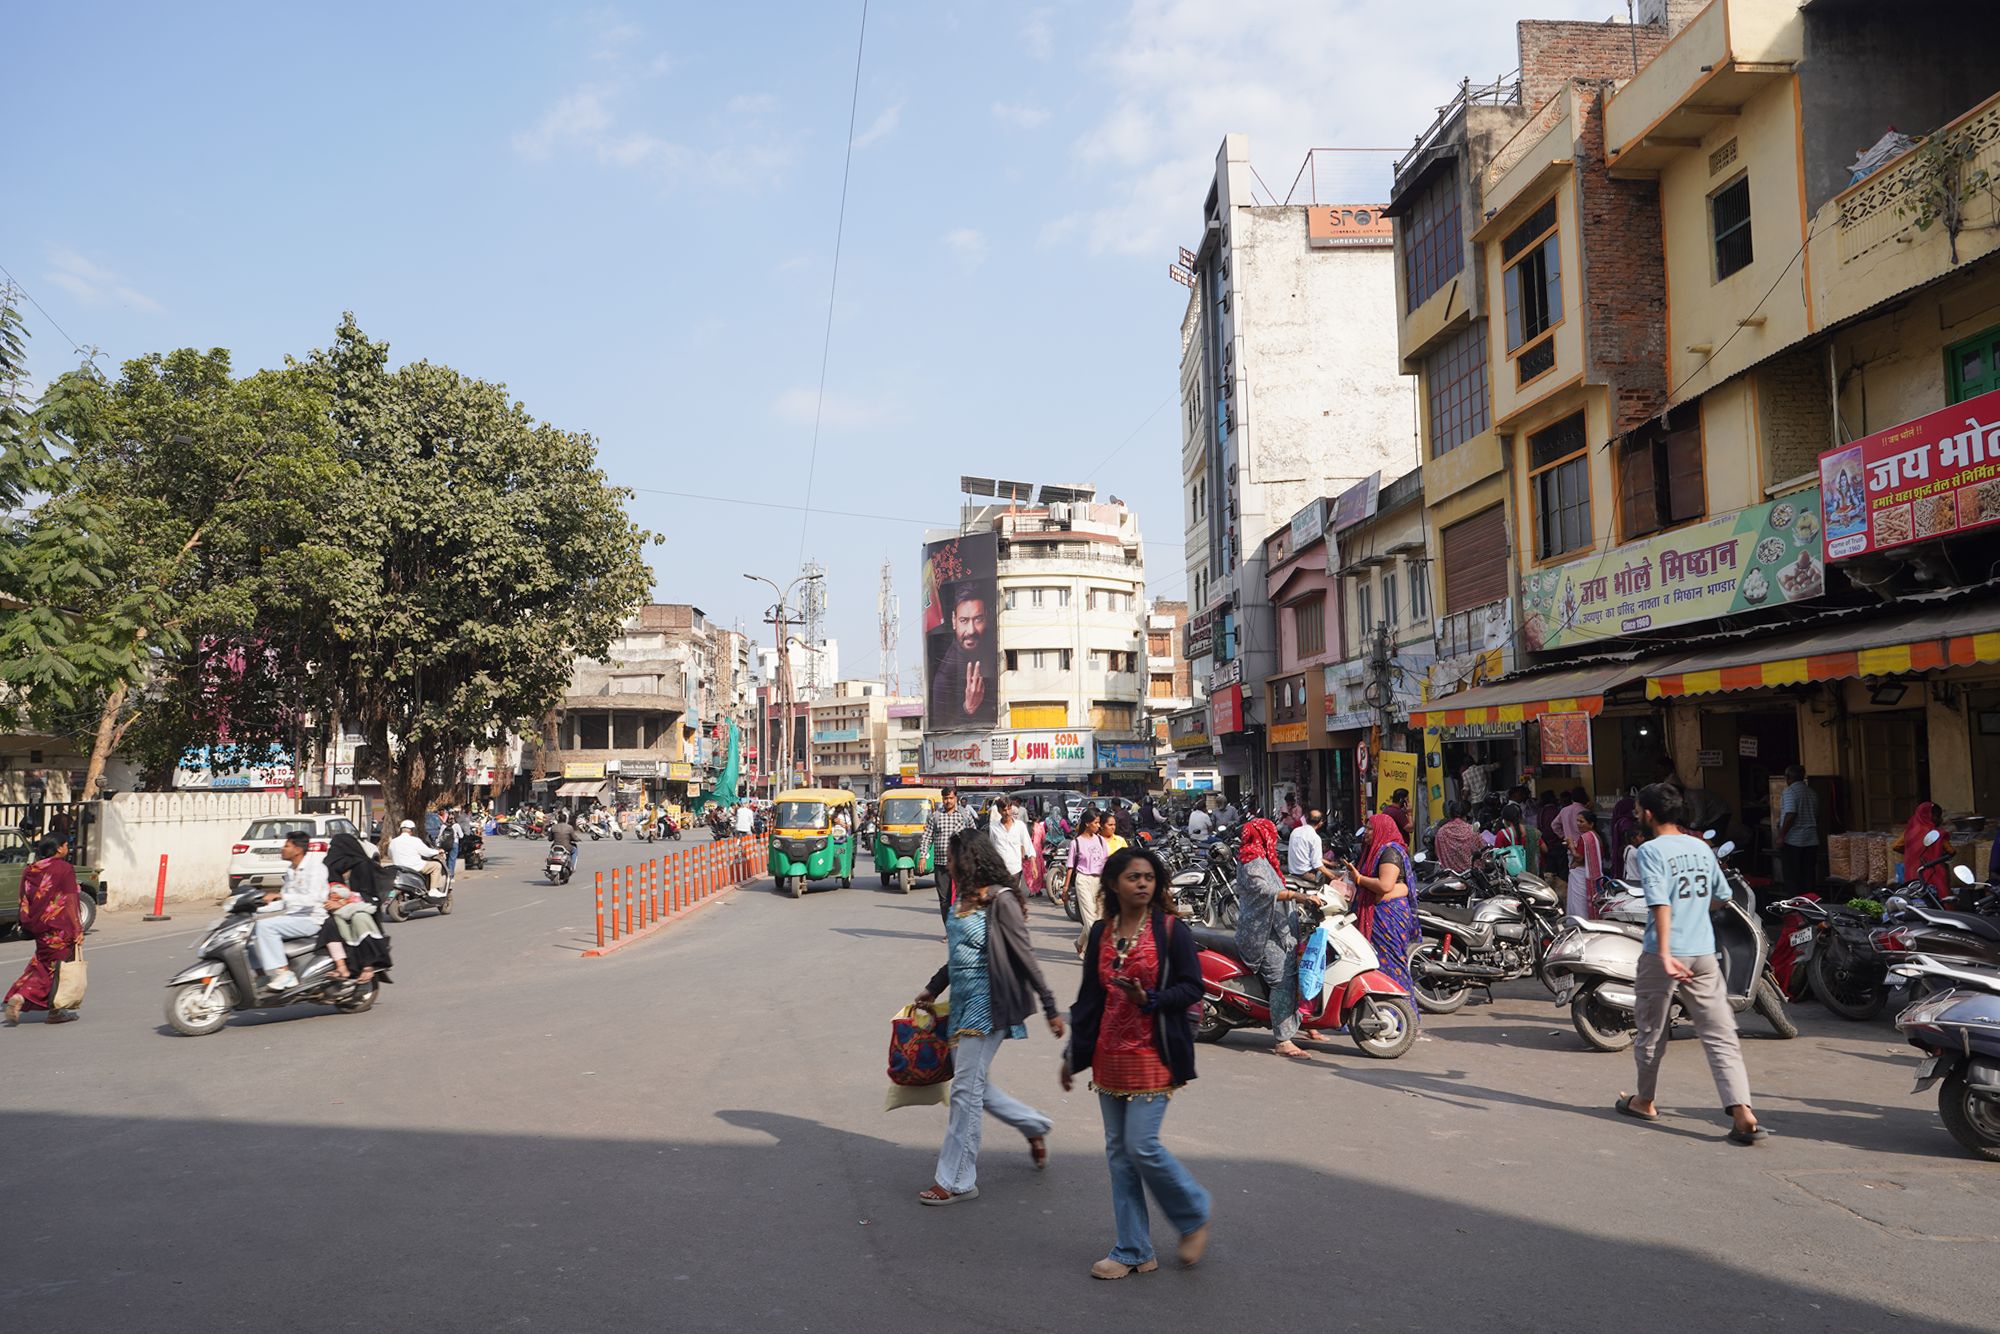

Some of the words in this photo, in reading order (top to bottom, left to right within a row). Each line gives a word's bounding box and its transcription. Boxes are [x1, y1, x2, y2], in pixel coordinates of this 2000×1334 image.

[1867, 444, 1933, 492] जय
[1873, 491, 1894, 509] हमारे
[1933, 477, 1950, 493] तेल
[1831, 541, 1845, 549] Name
[1851, 536, 1864, 545] Trust
[1579, 576, 1608, 605] जय
[1614, 556, 1653, 597] भोले
[1605, 607, 1616, 619] का
[1663, 594, 1670, 605] व
[1707, 578, 1737, 596] भण्डार
[1622, 619, 1636, 630] Since
[1055, 733, 1079, 745] SODA
[1056, 746, 1085, 760] SHAKE
[1668, 853, 1710, 877] BULLS
[1678, 875, 1709, 899] 23
